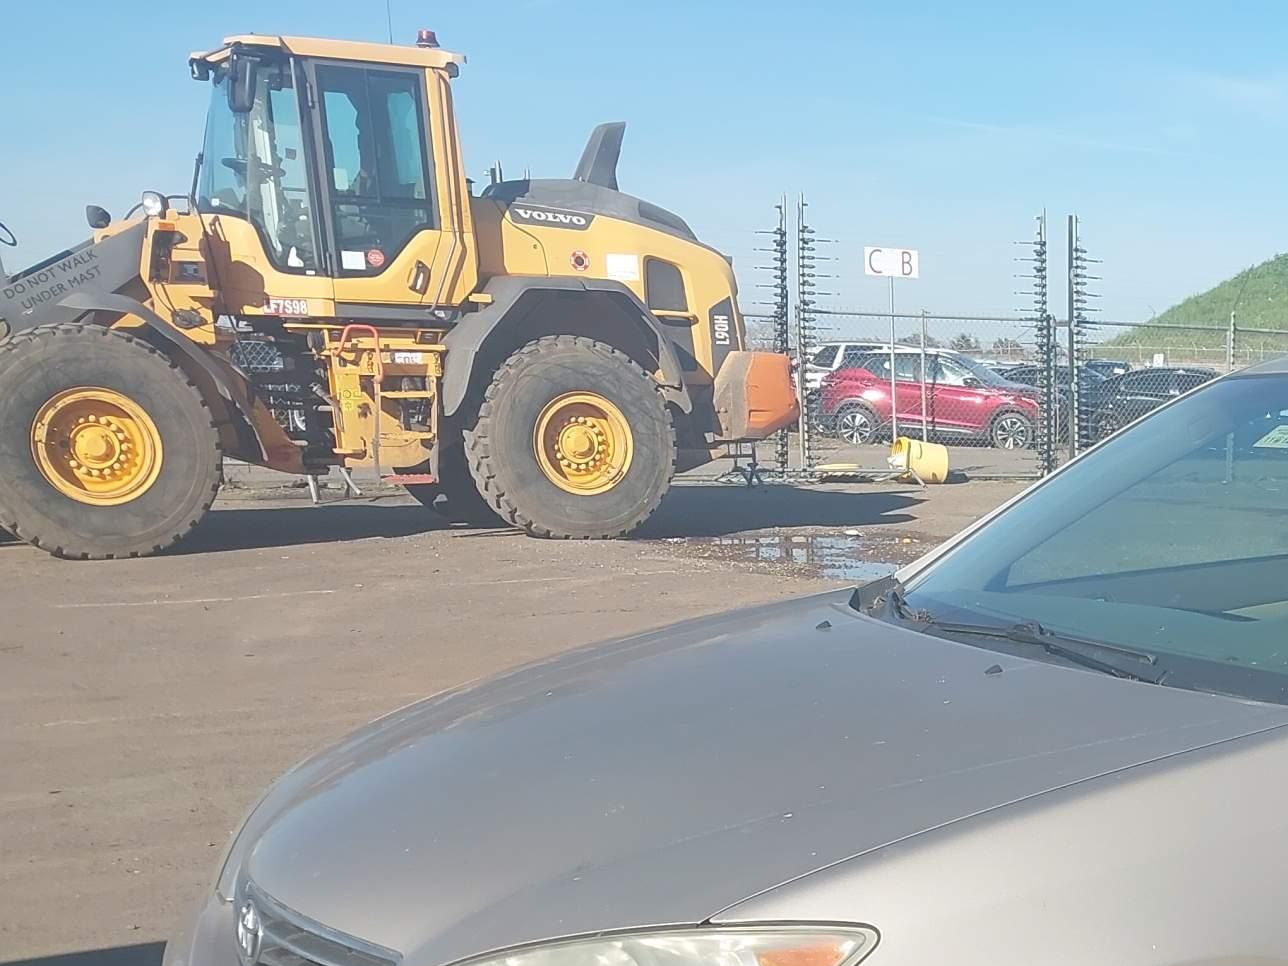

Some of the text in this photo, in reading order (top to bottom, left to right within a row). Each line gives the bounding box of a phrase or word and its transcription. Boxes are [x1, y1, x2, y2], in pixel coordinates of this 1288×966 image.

[514, 208, 587, 226] VOLVO
[3, 249, 98, 299] DO NOT WALK
[869, 249, 913, 276] C B
[21, 265, 102, 309] UNDER MAST
[713, 315, 730, 345] L90H
